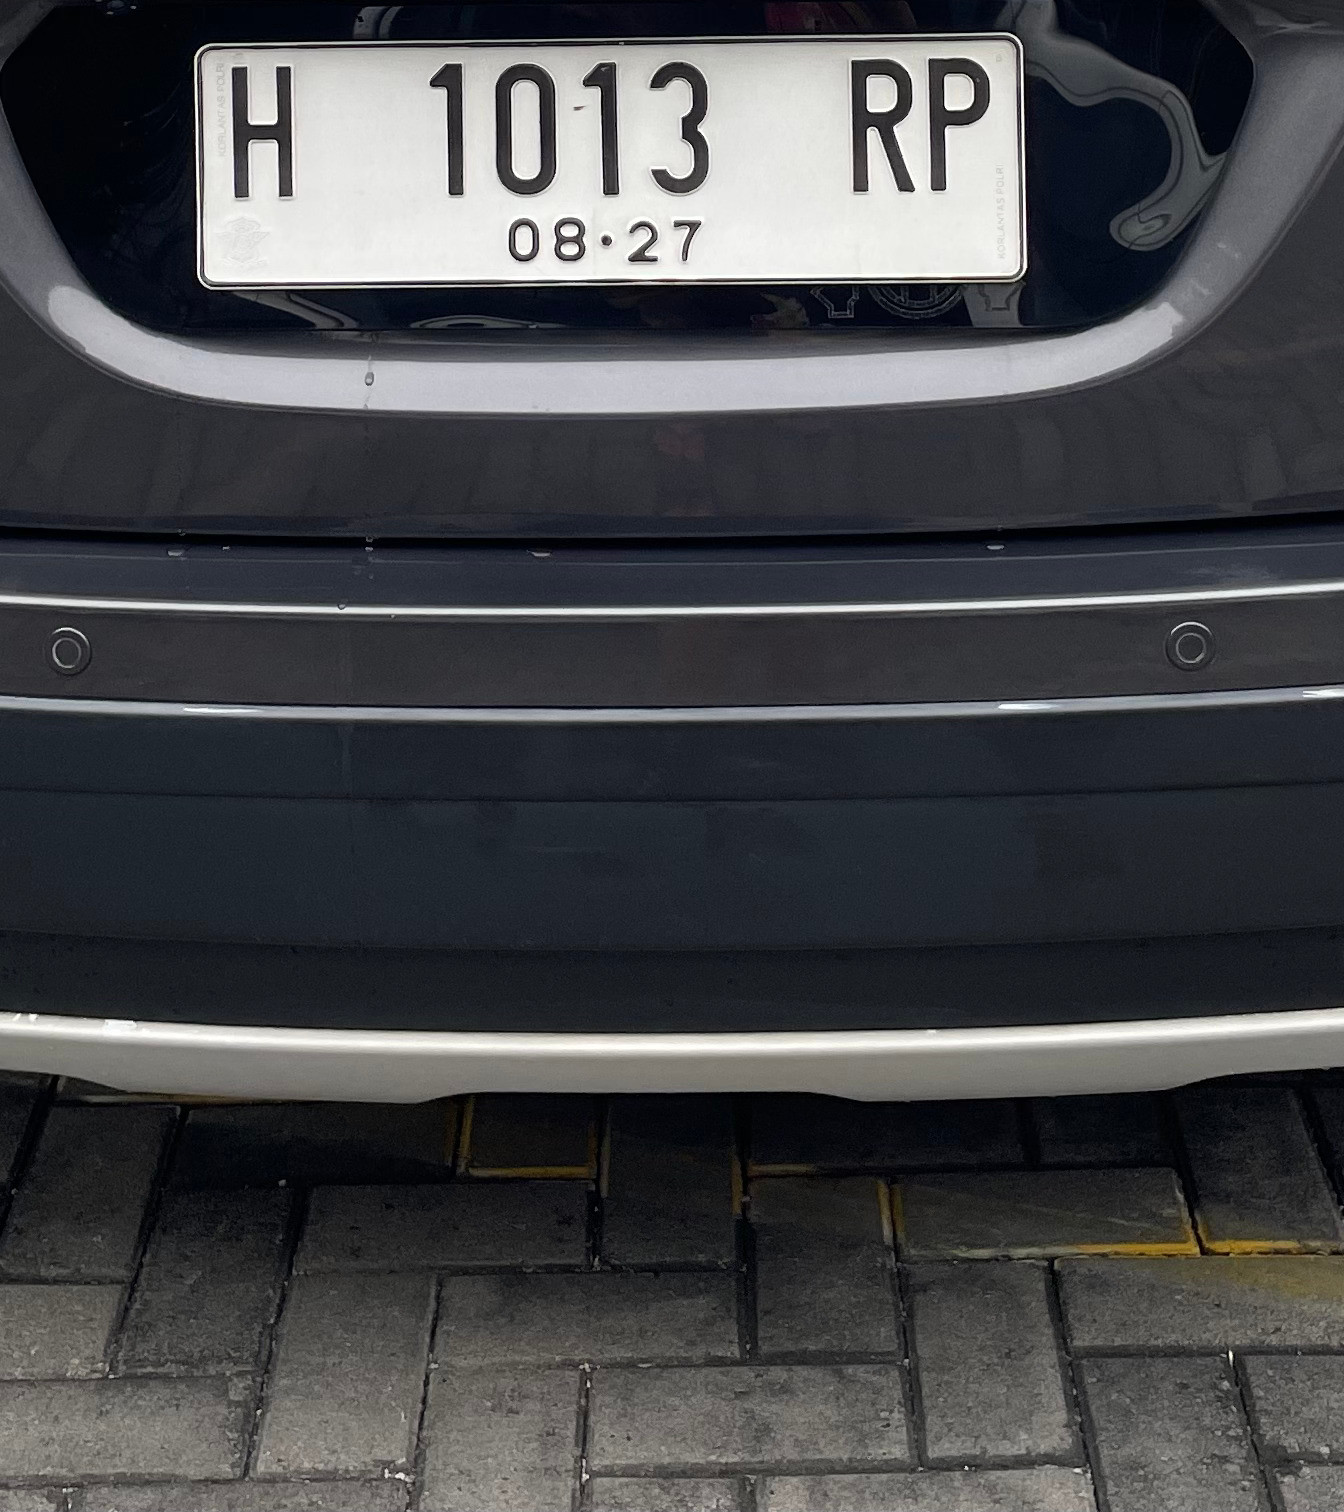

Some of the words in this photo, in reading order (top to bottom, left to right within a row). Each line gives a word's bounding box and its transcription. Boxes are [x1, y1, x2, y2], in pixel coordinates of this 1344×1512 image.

[216, 63, 226, 92] POLRI
[216, 95, 227, 158] KORLANTAS
[232, 66, 293, 199] H
[430, 61, 710, 196] 1013
[850, 58, 991, 193] RP
[995, 164, 1006, 195] POLRI
[995, 197, 1006, 259] KORLANTAS
